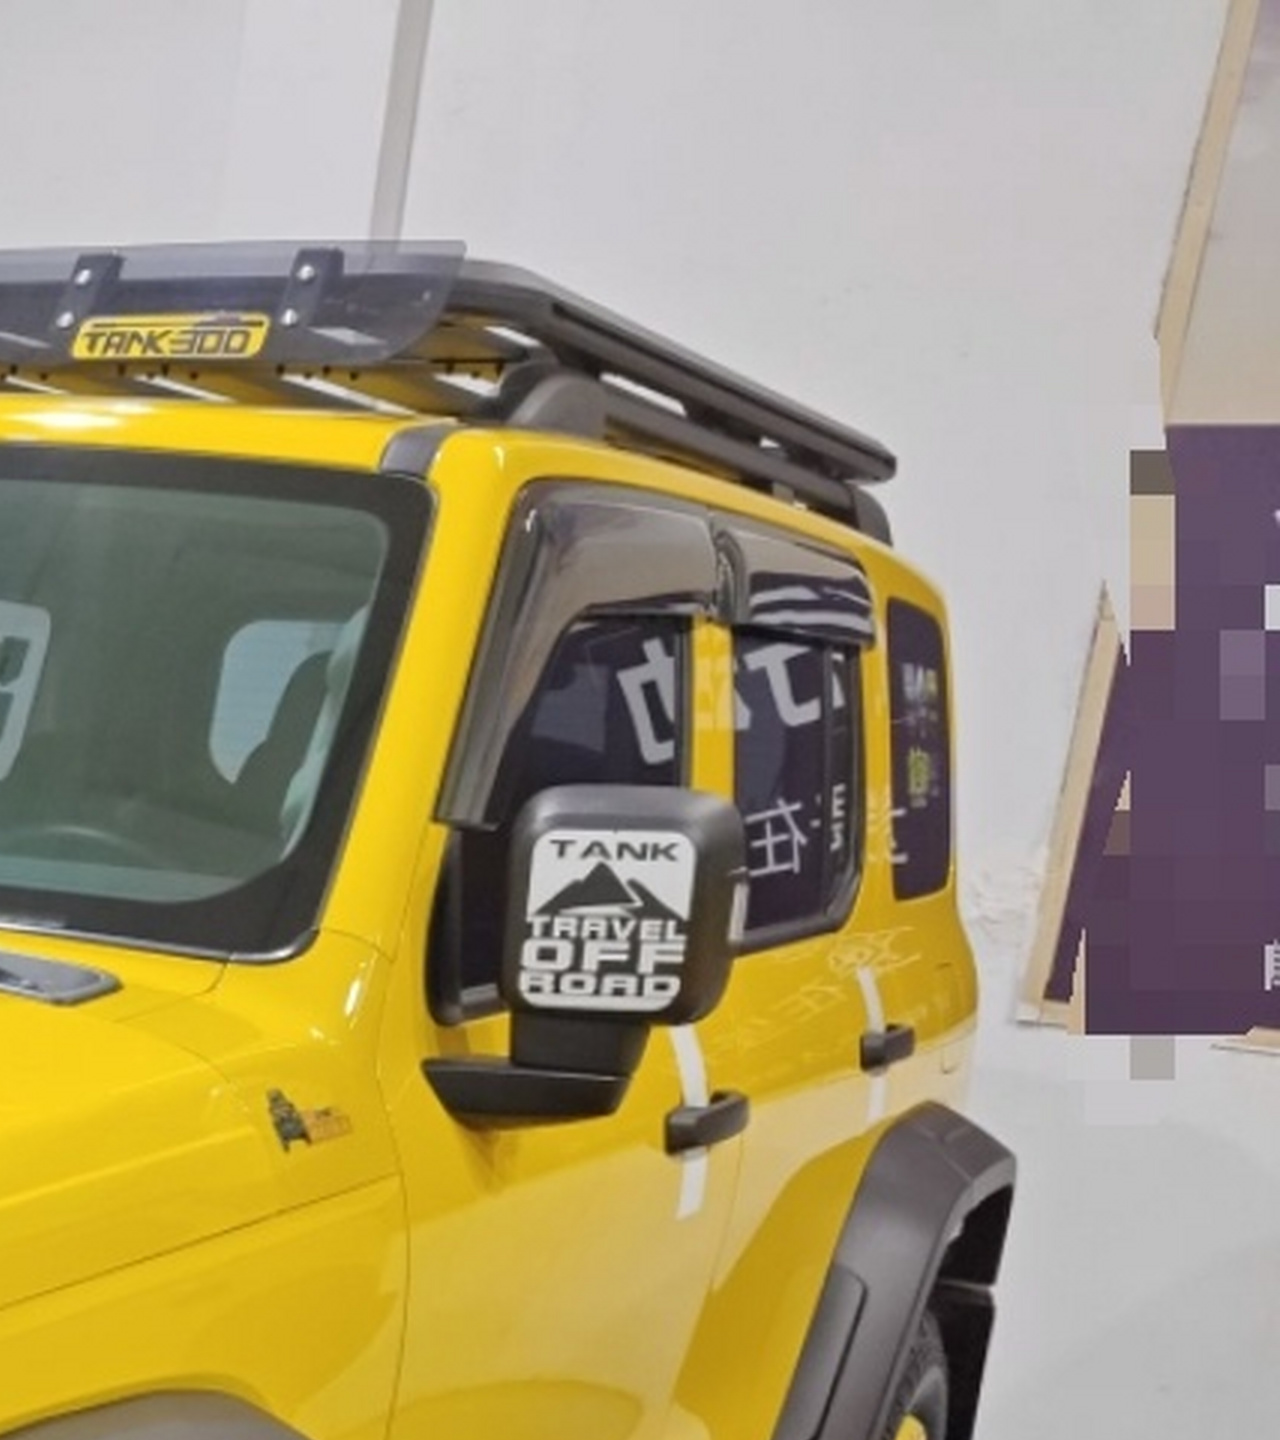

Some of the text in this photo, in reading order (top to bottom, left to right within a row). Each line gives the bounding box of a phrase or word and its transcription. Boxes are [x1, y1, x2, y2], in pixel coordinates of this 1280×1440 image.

[549, 839, 679, 862] TANK
[527, 915, 687, 941] TRAVEL
[521, 938, 685, 974] OFF
[519, 970, 681, 997] ROAD
